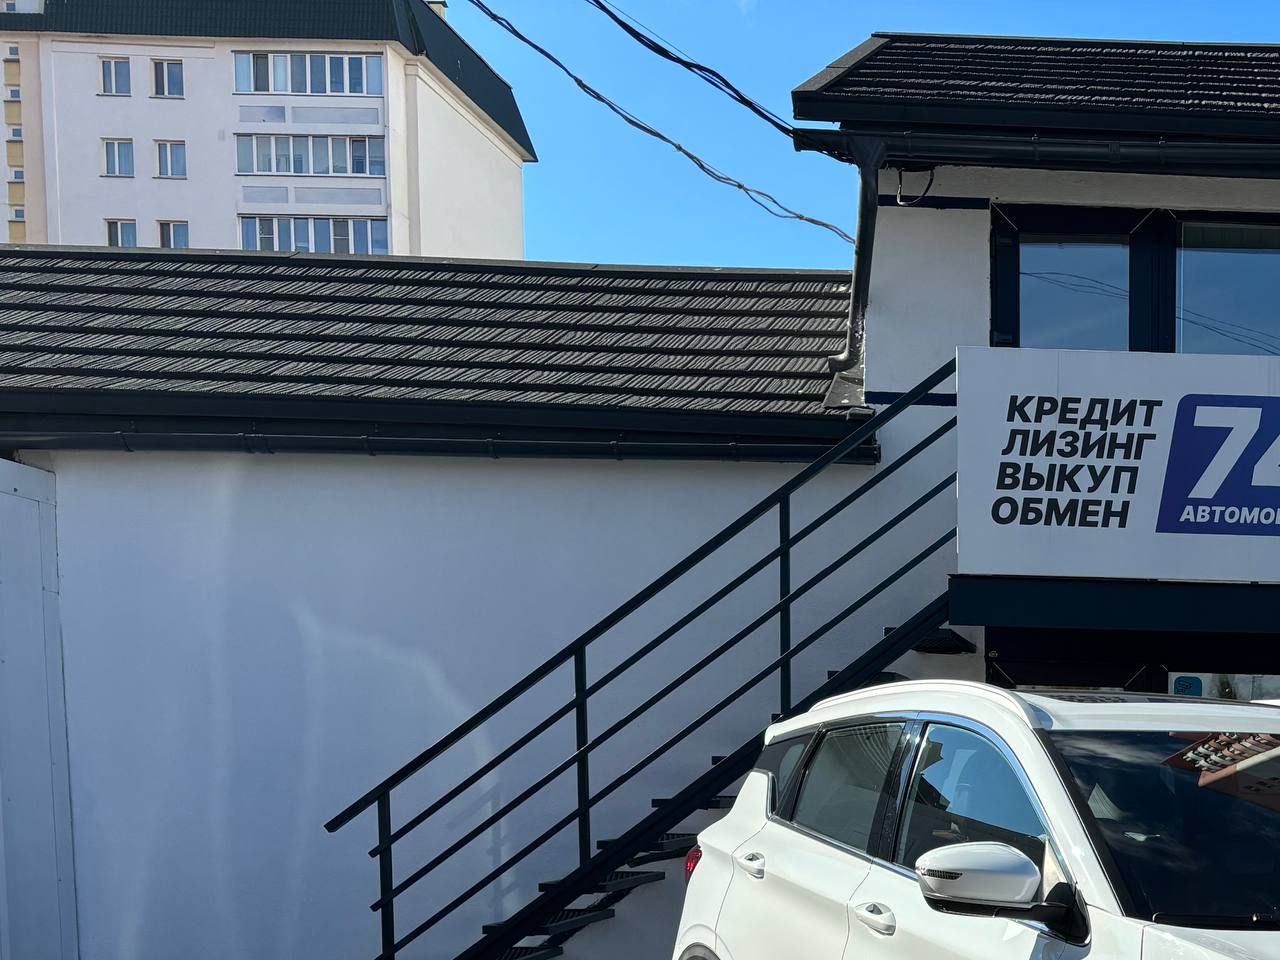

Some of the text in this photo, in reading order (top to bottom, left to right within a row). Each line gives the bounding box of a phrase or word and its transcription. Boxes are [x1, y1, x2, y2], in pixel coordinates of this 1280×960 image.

[1006, 395, 1163, 431] КРЕДИТ
[1001, 429, 1156, 461] ЛИЗИНГ
[996, 463, 1139, 494] ВЫКУП
[990, 496, 1130, 528] ОБМЕН
